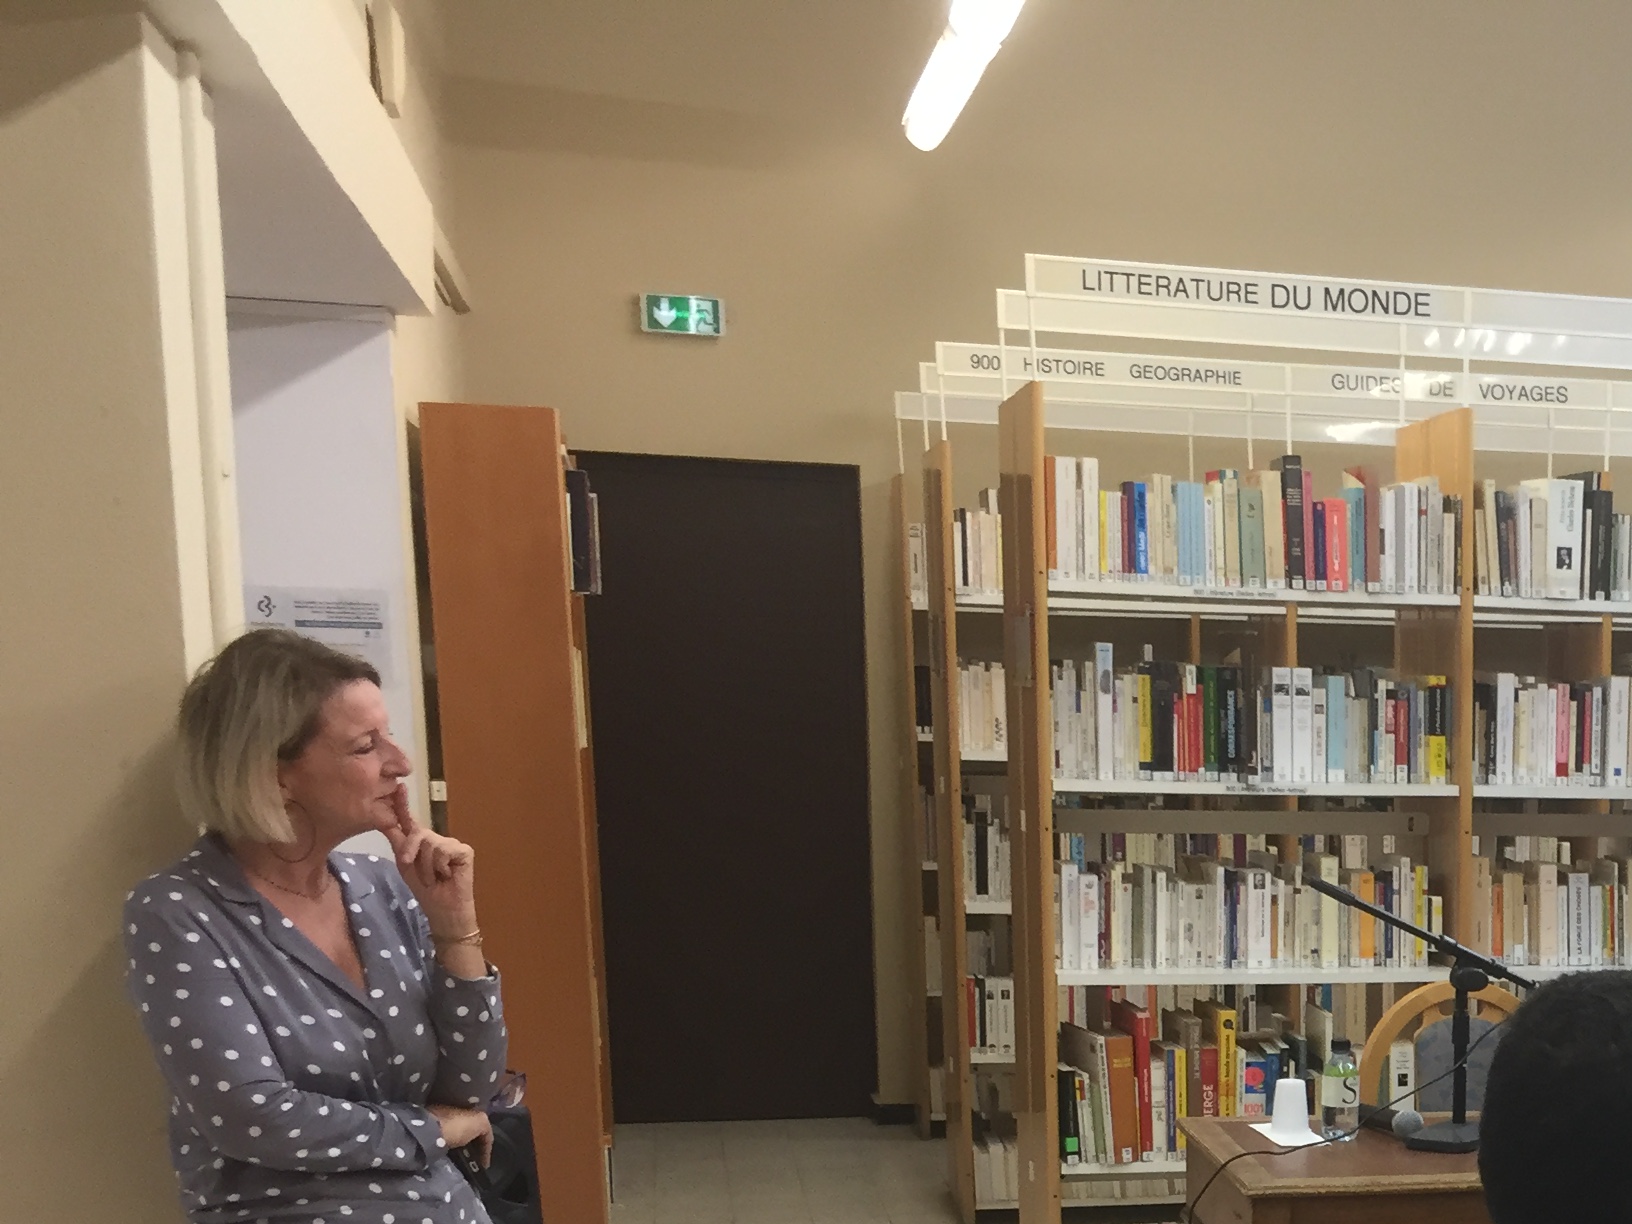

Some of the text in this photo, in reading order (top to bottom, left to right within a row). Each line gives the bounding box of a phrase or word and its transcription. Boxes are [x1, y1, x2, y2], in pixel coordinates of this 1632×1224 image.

[1082, 268, 1432, 318] LITTERATURE DU MONDE
[970, 353, 1243, 387] 900 HISTOIRE GEOGRAPHIE
[1429, 379, 1455, 398] DE
[1478, 382, 1570, 404] VOYAGES
